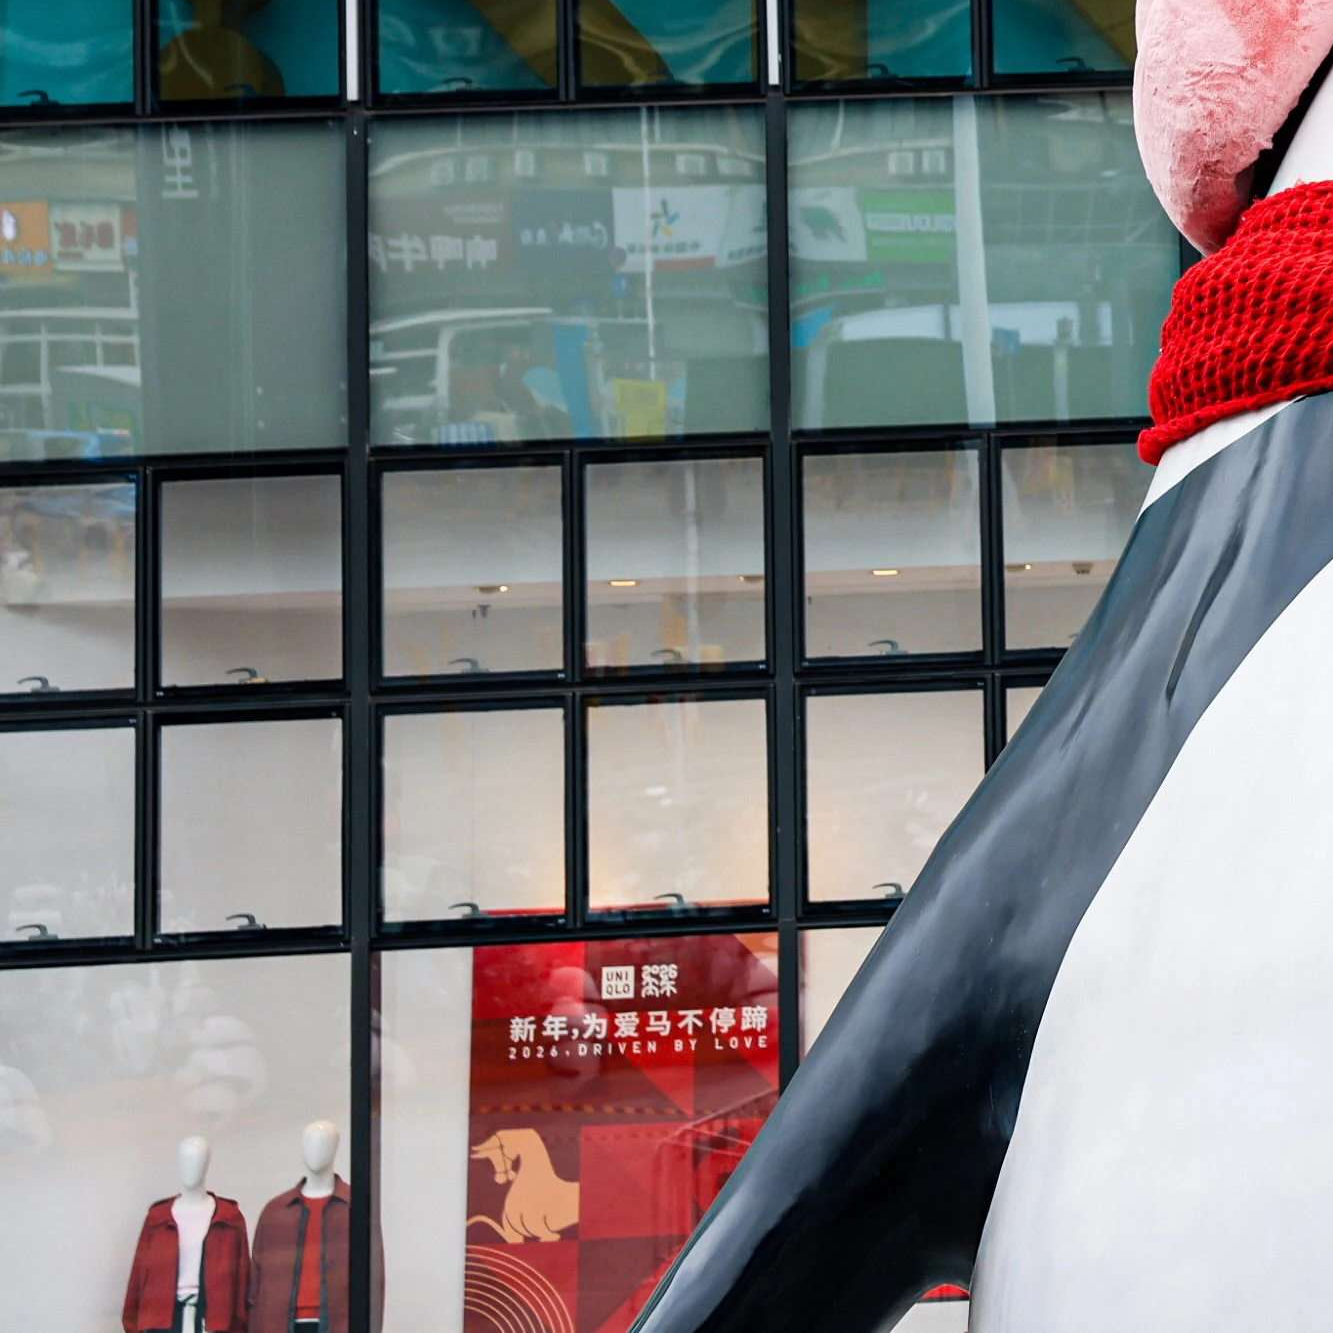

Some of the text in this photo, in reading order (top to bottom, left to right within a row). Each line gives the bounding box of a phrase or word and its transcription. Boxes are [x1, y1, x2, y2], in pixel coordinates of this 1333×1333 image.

[606, 970, 629, 982] UNI
[606, 983, 631, 996] QLO
[578, 1040, 657, 1057] DRIVEN
[674, 1037, 698, 1052] BY
[714, 1035, 768, 1050] LOVE
